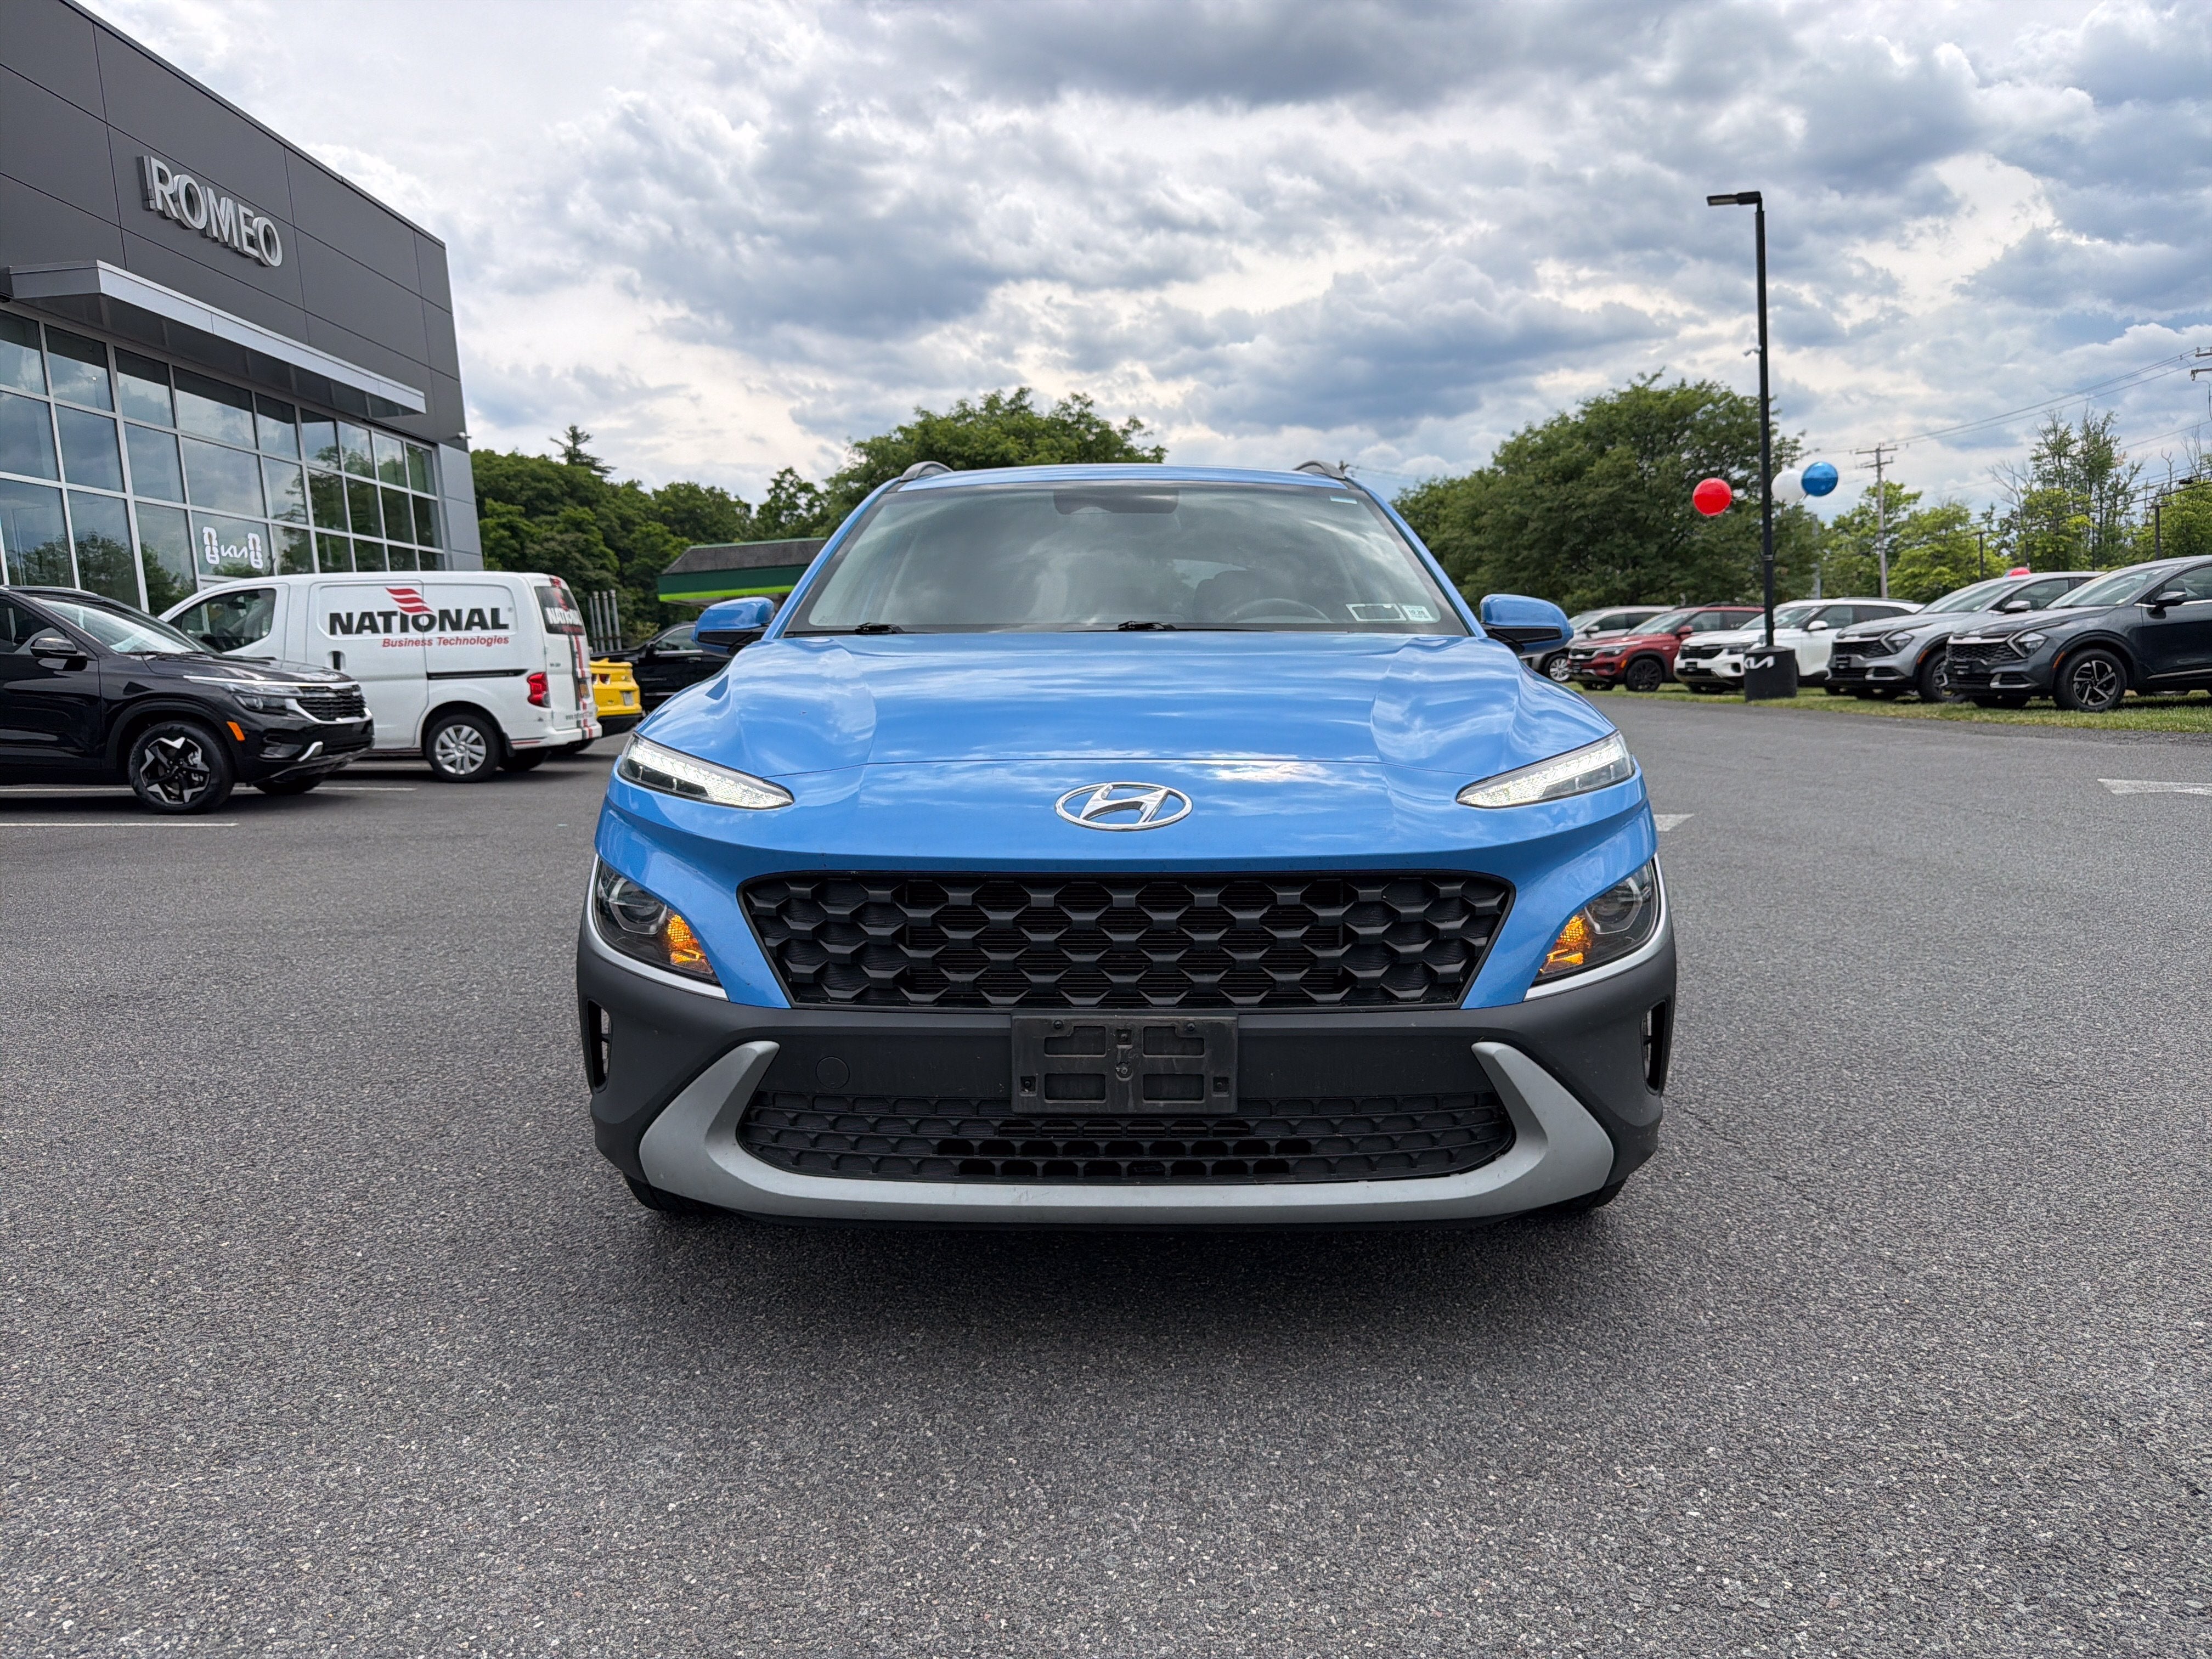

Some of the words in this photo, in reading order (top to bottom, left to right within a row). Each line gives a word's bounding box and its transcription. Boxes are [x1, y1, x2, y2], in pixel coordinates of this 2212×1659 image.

[143, 155, 283, 267] ROMEO
[329, 608, 510, 635] NATIONAL
[382, 638, 433, 647] Business
[437, 635, 510, 647] Technologies
